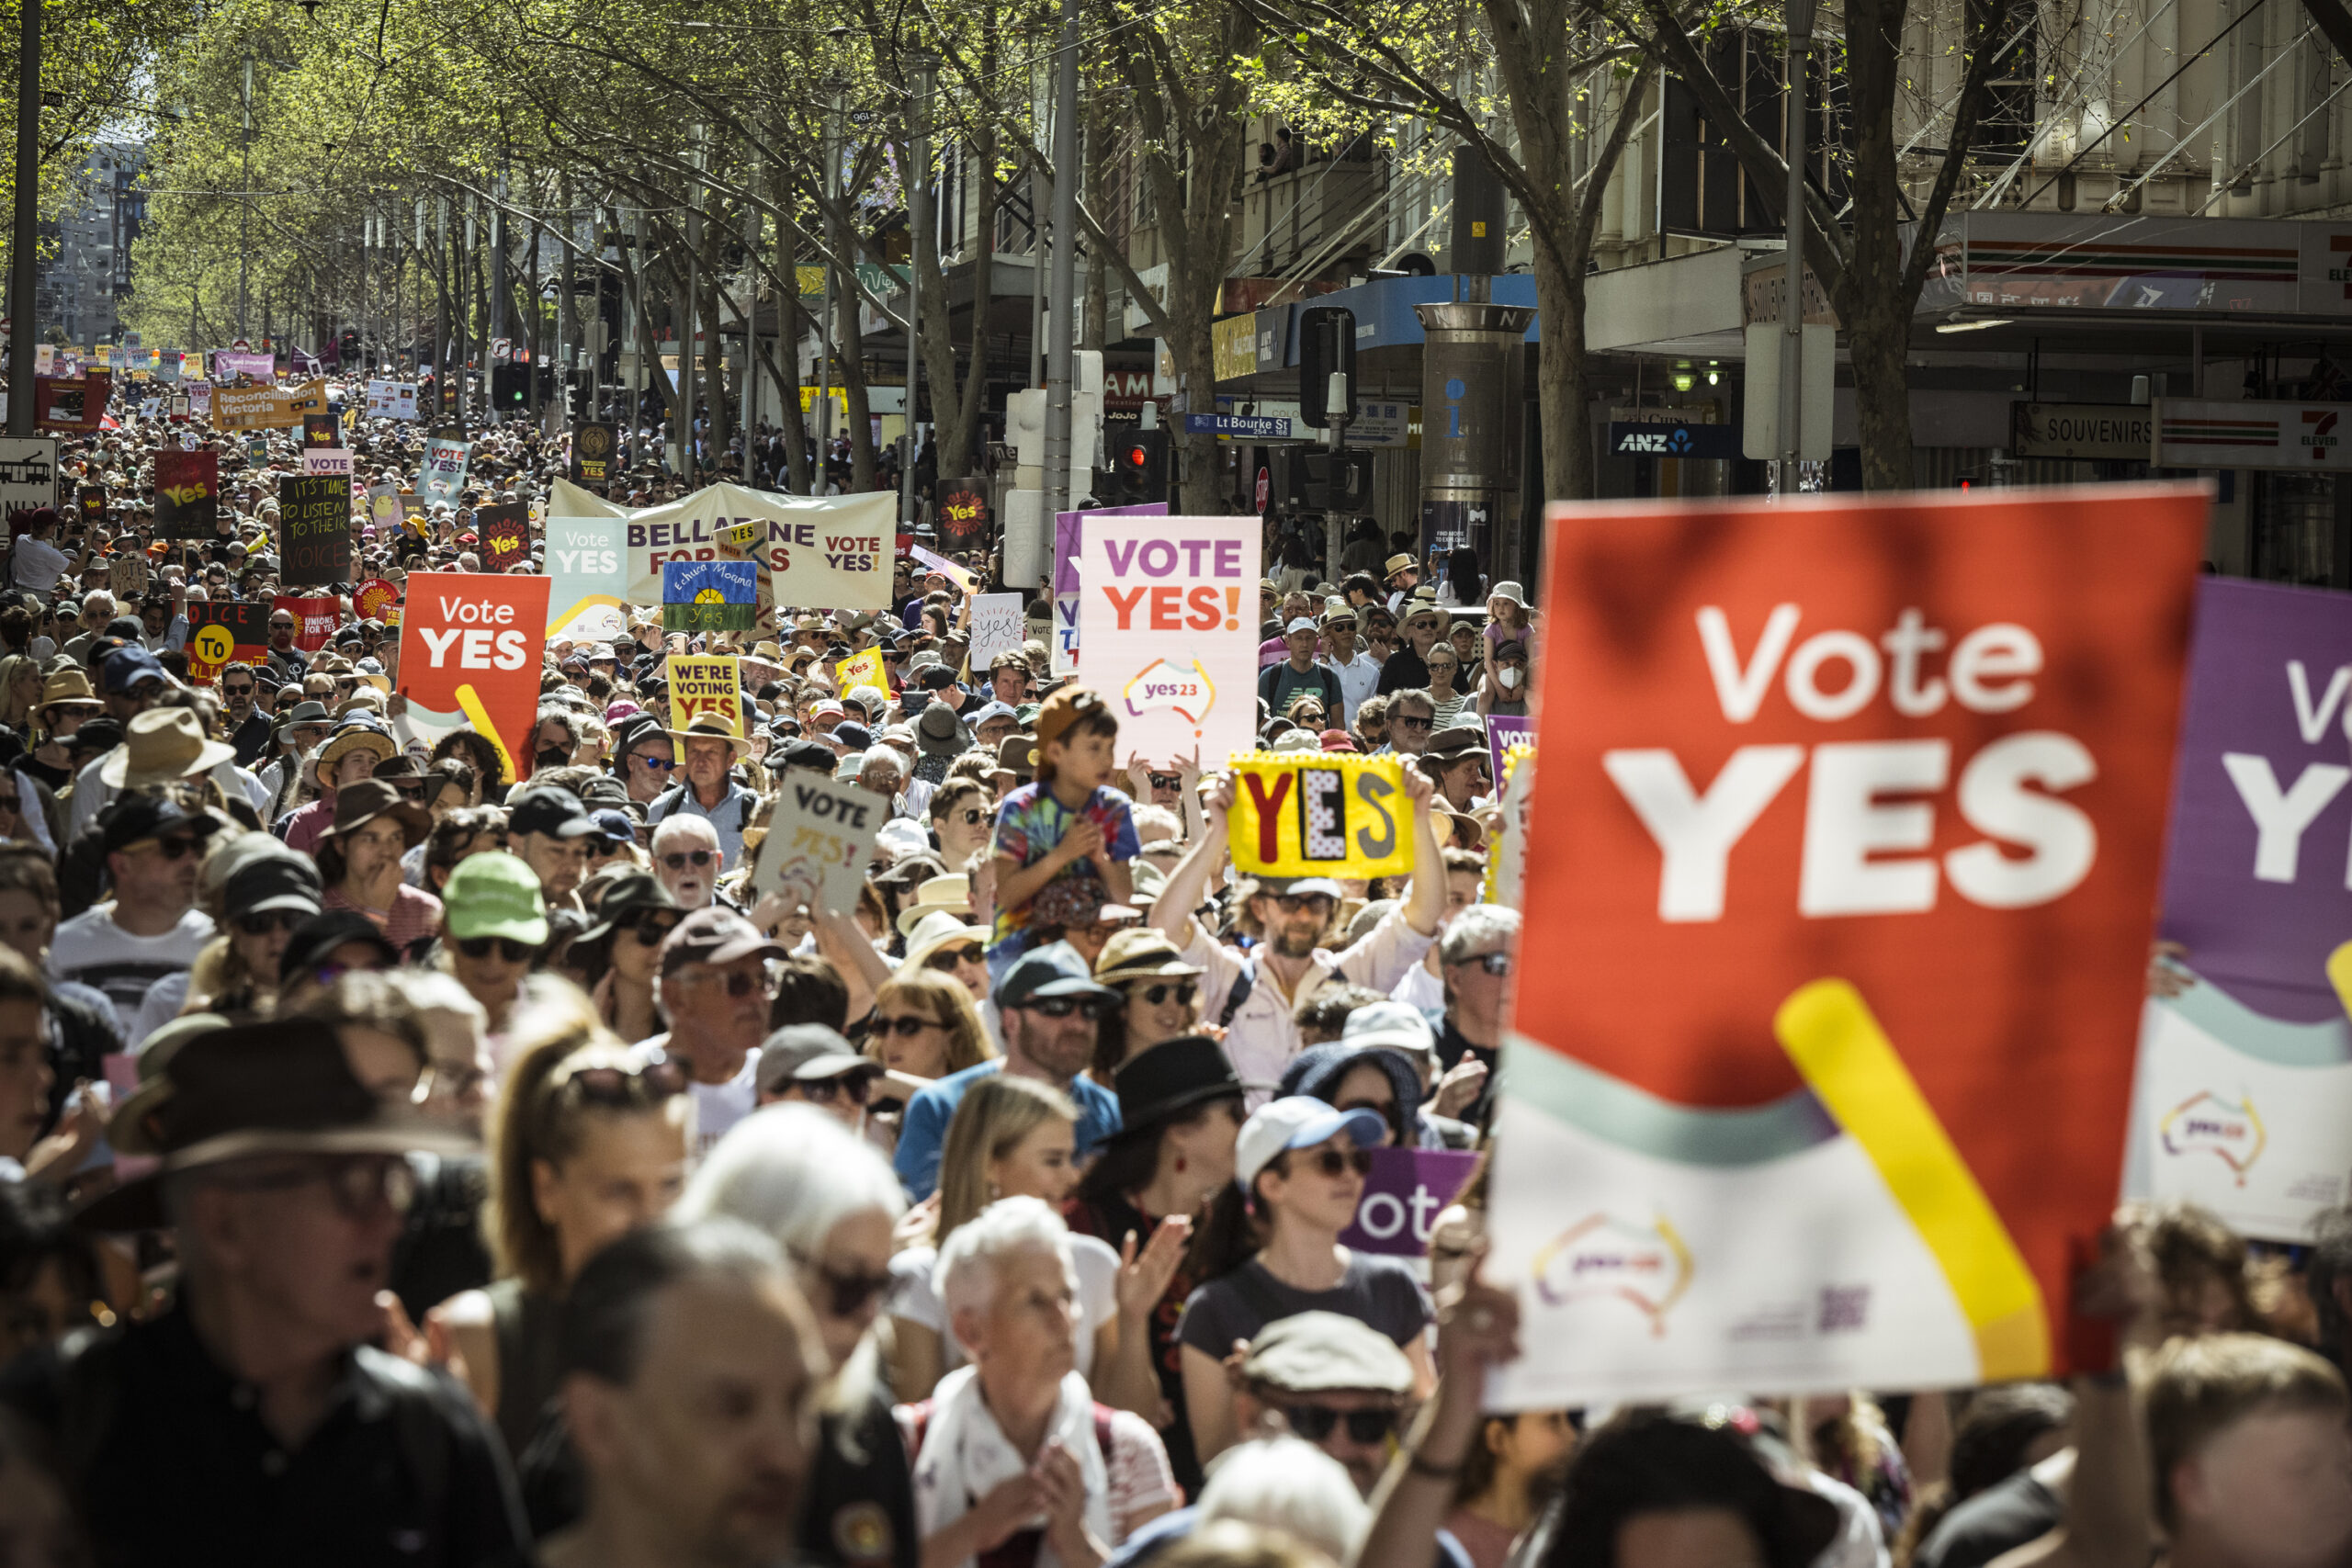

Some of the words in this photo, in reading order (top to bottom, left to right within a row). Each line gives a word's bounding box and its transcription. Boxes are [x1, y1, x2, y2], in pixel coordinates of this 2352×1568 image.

[220, 387, 317, 403] Reconciliation
[220, 401, 275, 414] Victoria
[1216, 417, 1228, 428] Lt
[1231, 417, 1272, 430] Bourke
[1275, 419, 1288, 430] St
[2048, 419, 2152, 443] SOUVENIRS
[311, 431, 331, 442] Yes
[1618, 434, 1668, 452] ANZ
[252, 449, 265, 457] Yes
[431, 447, 466, 461] VOTE
[310, 458, 348, 470] VOTE
[428, 458, 463, 473] YES!
[582, 467, 605, 477] YES
[163, 481, 208, 508] Yes
[295, 478, 317, 499] IT'S
[322, 479, 349, 496] TIME
[85, 499, 101, 509] Yes
[281, 503, 298, 521] TO
[302, 502, 345, 519] LISTEN
[946, 505, 977, 521] Yes
[289, 521, 308, 539] TO
[311, 516, 347, 534] THEIR
[628, 517, 816, 547] BELLANE
[731, 525, 754, 541] YES
[489, 535, 519, 556] Yes
[565, 531, 609, 547] Vote
[825, 536, 881, 552] VOTE
[286, 542, 348, 569] VOICE
[895, 546, 906, 556] es
[1103, 539, 1241, 577] VOTE
[555, 550, 618, 574] YES
[825, 554, 880, 571] YES!
[674, 563, 707, 591] Echuca
[712, 562, 752, 588] Moama
[356, 580, 378, 596] UNIONS
[172, 602, 249, 625] OICE
[439, 596, 514, 624] Vote
[1102, 586, 1240, 631] YES!
[304, 615, 334, 626] UNIONS
[323, 624, 336, 633] YES
[1032, 625, 1052, 635] VOTE
[418, 627, 527, 671] YES
[846, 661, 869, 676] Yes
[1694, 602, 2045, 725] Vote
[674, 665, 732, 680] WE'RE
[676, 682, 734, 694] VOTING
[677, 697, 736, 721] YES
[795, 784, 868, 829] VOTE
[1243, 768, 1395, 863] YES
[1600, 730, 2099, 925] YES
[791, 827, 858, 867] YES!
